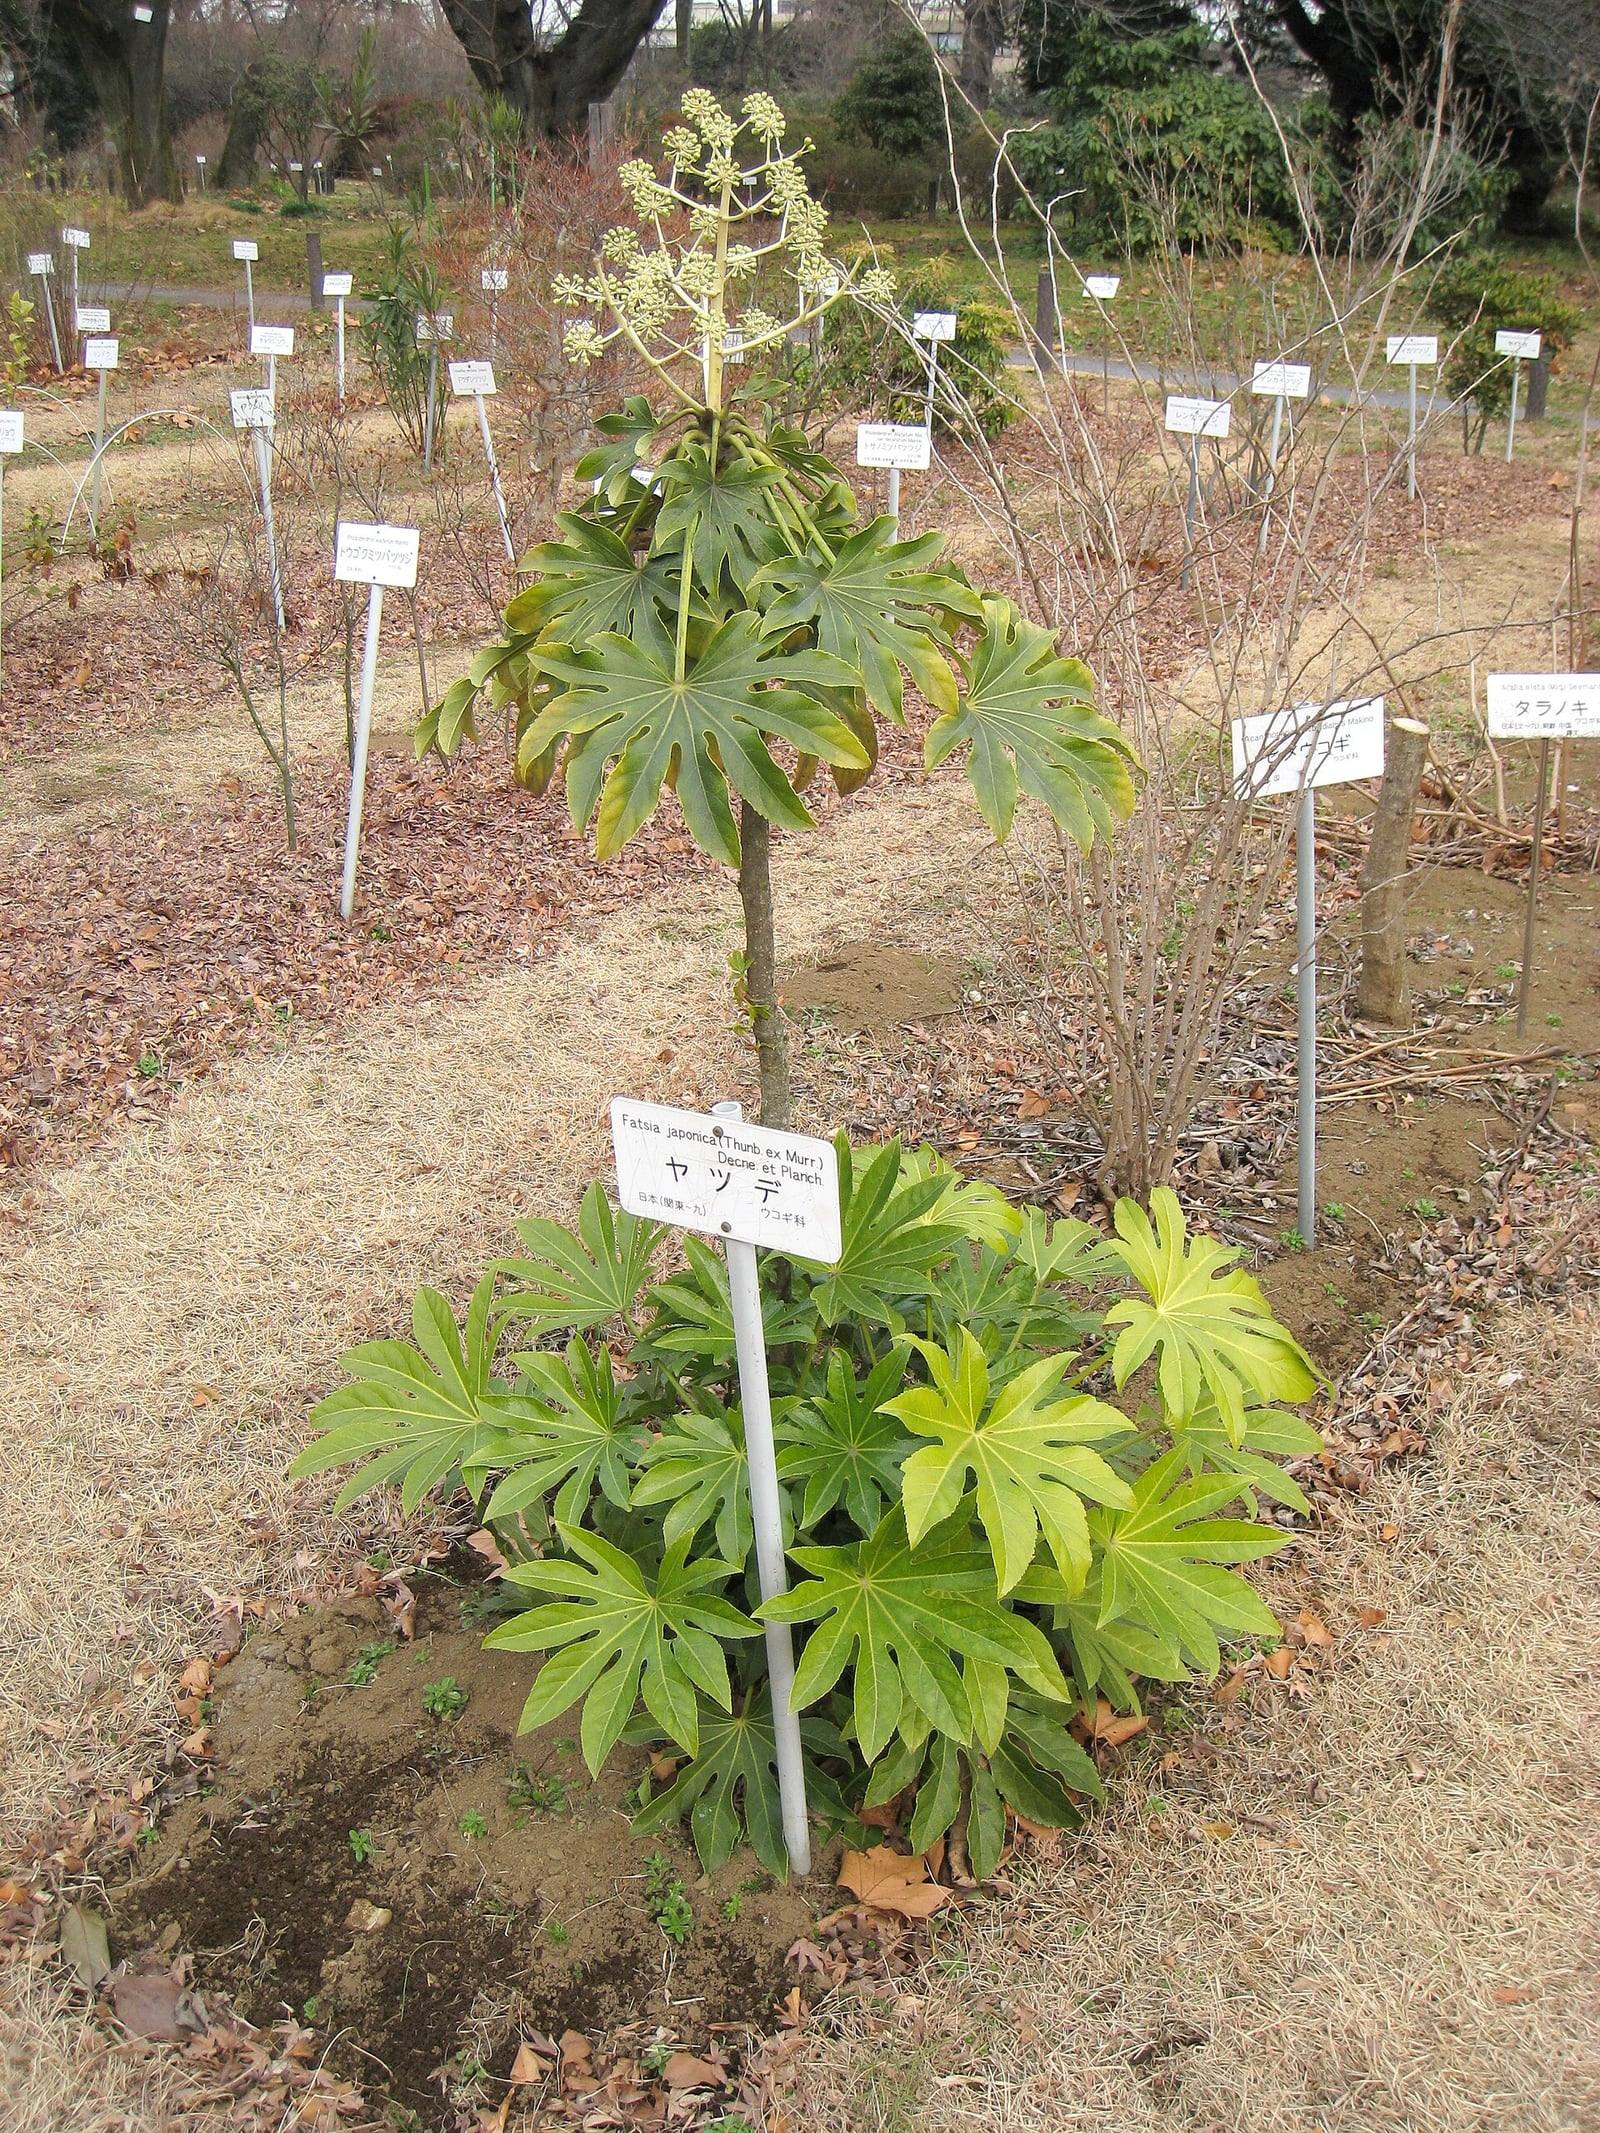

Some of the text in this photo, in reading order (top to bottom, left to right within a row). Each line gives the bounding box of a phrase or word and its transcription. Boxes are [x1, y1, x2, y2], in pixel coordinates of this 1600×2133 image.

[340, 545, 414, 565] トウゴクミツバツツジ
[1515, 699, 1589, 717] タラノキ
[621, 1113, 661, 1134] Fatsia
[667, 1124, 717, 1146] japonica
[766, 1148, 781, 1160] ex
[762, 1163, 776, 1175] et
[760, 1207, 806, 1229] ウコギ科
